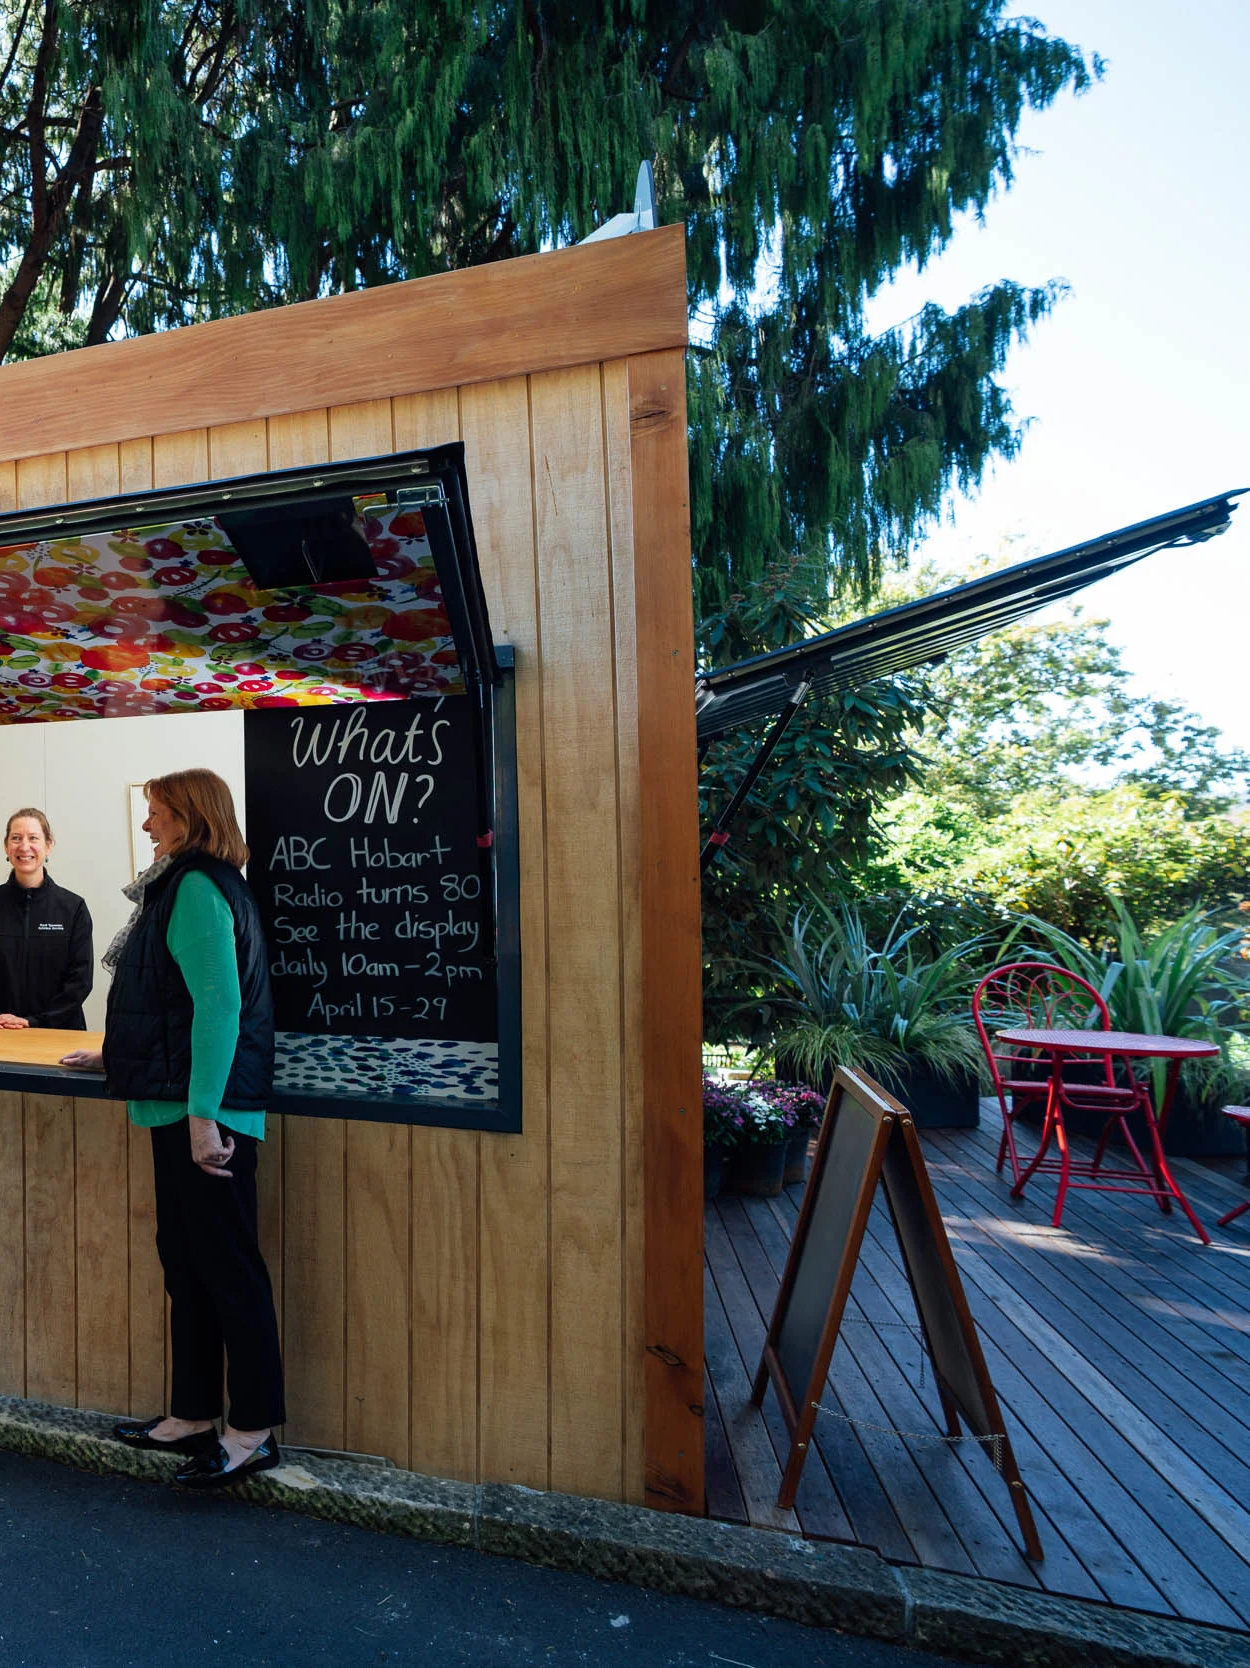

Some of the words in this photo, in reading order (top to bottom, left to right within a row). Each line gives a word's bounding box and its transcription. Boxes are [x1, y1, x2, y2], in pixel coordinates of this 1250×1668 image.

[290, 696, 451, 768] What's
[323, 771, 435, 825] ON?
[269, 836, 332, 872] ABC
[349, 835, 452, 869] Hobart
[273, 882, 343, 908] Radio
[356, 876, 429, 904] turns
[439, 873, 481, 902] 80
[273, 916, 321, 944] See
[335, 909, 381, 941] the
[394, 908, 480, 953] display
[270, 947, 328, 988] daily
[306, 992, 362, 1026] April
